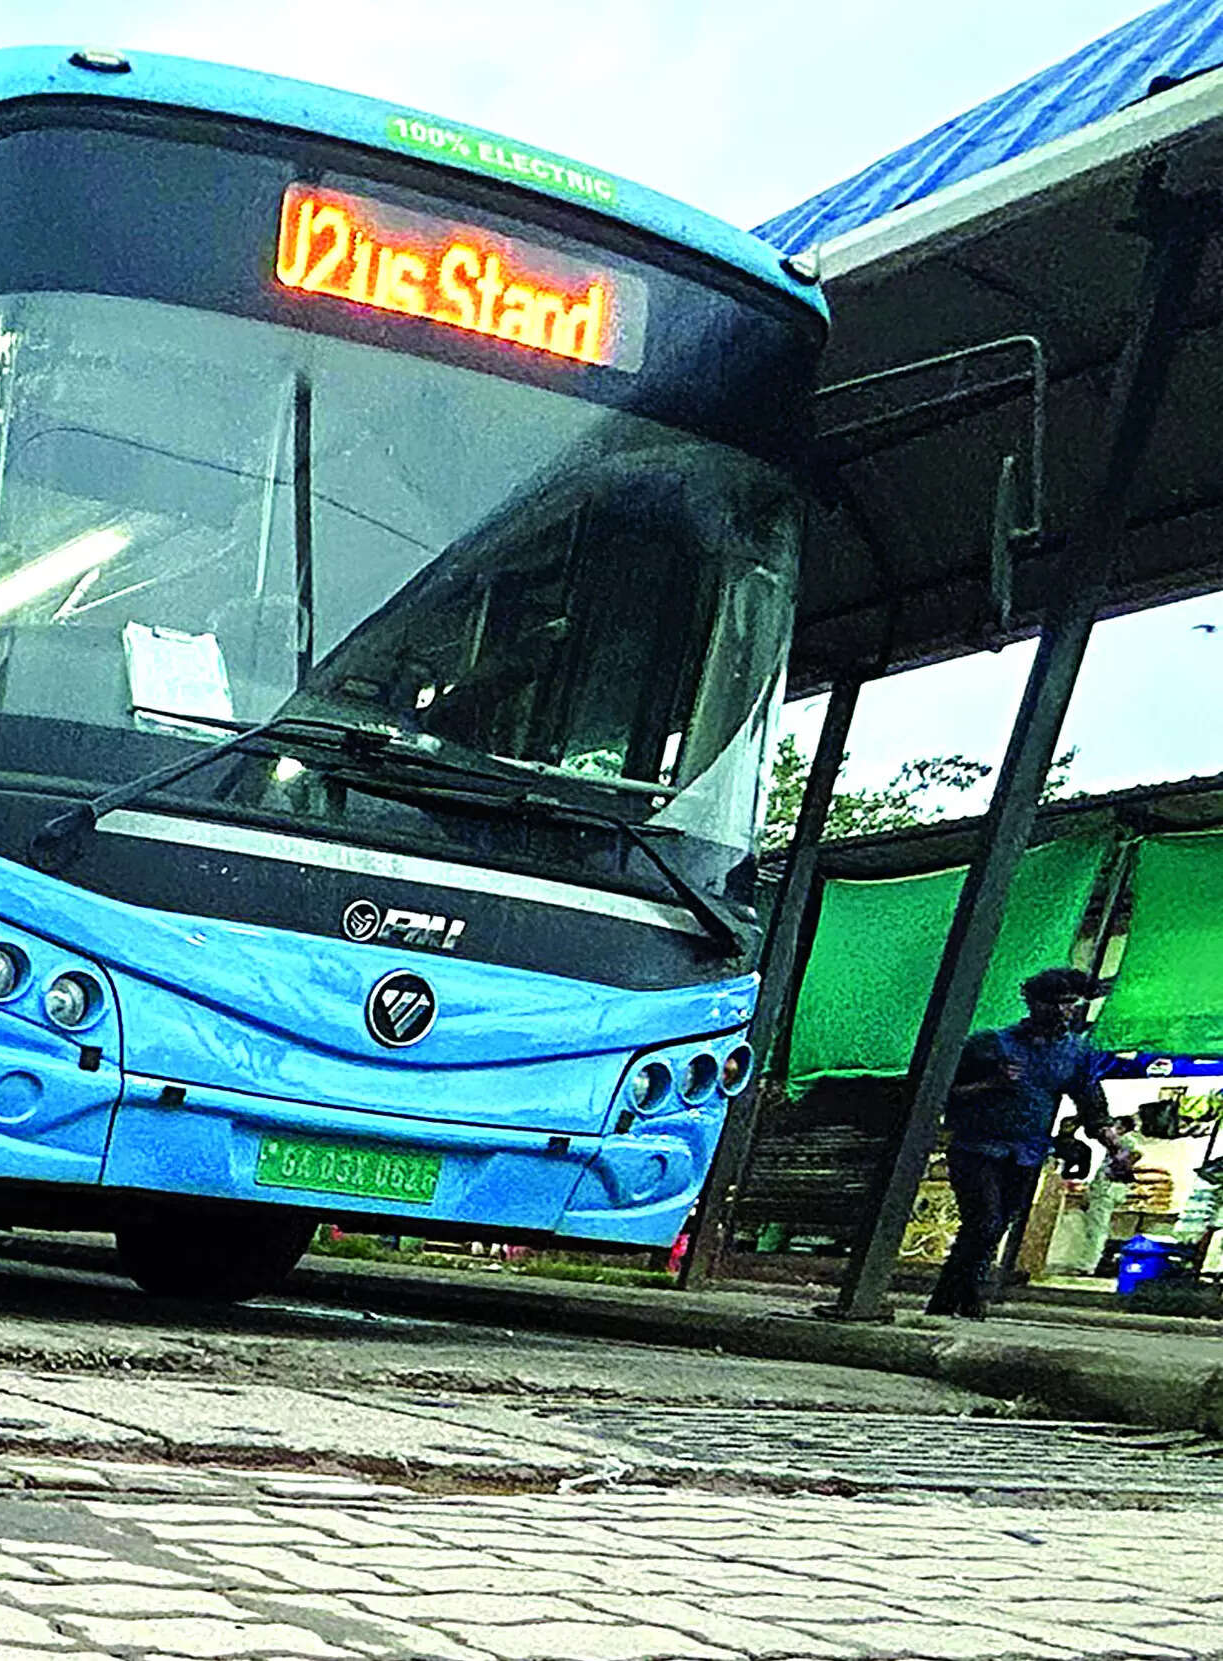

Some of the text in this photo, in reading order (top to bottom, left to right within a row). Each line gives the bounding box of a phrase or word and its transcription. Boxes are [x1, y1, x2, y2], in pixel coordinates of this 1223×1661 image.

[393, 117, 612, 200] 100% ELECTRIC
[436, 242, 606, 363] Stand
